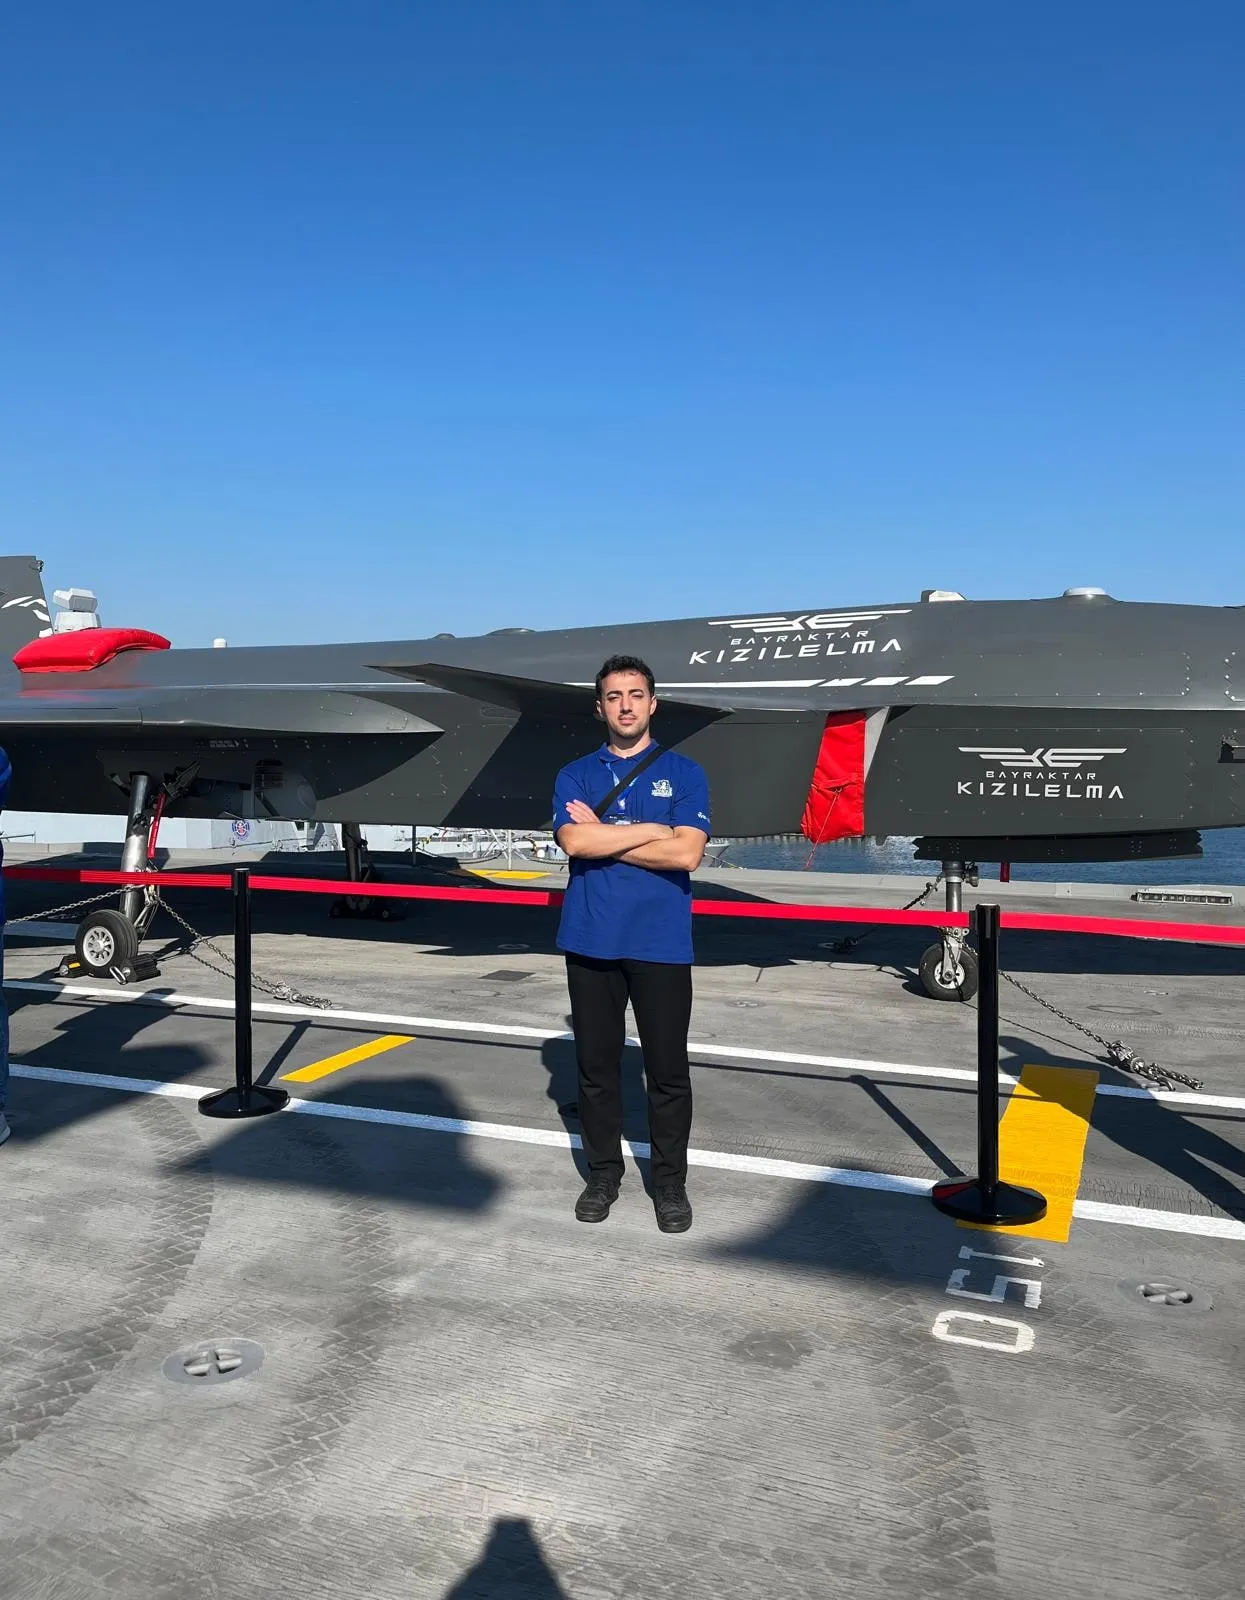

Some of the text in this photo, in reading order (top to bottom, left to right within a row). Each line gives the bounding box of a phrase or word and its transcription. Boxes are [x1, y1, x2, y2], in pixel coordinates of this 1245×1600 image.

[729, 630, 869, 646] BAYRAKTAR
[688, 638, 902, 665] KIZILELMA
[985, 770, 1096, 781] BAYRAKTAR
[957, 781, 1125, 800] KIZILELMA
[931, 1245, 1046, 1354] 150
